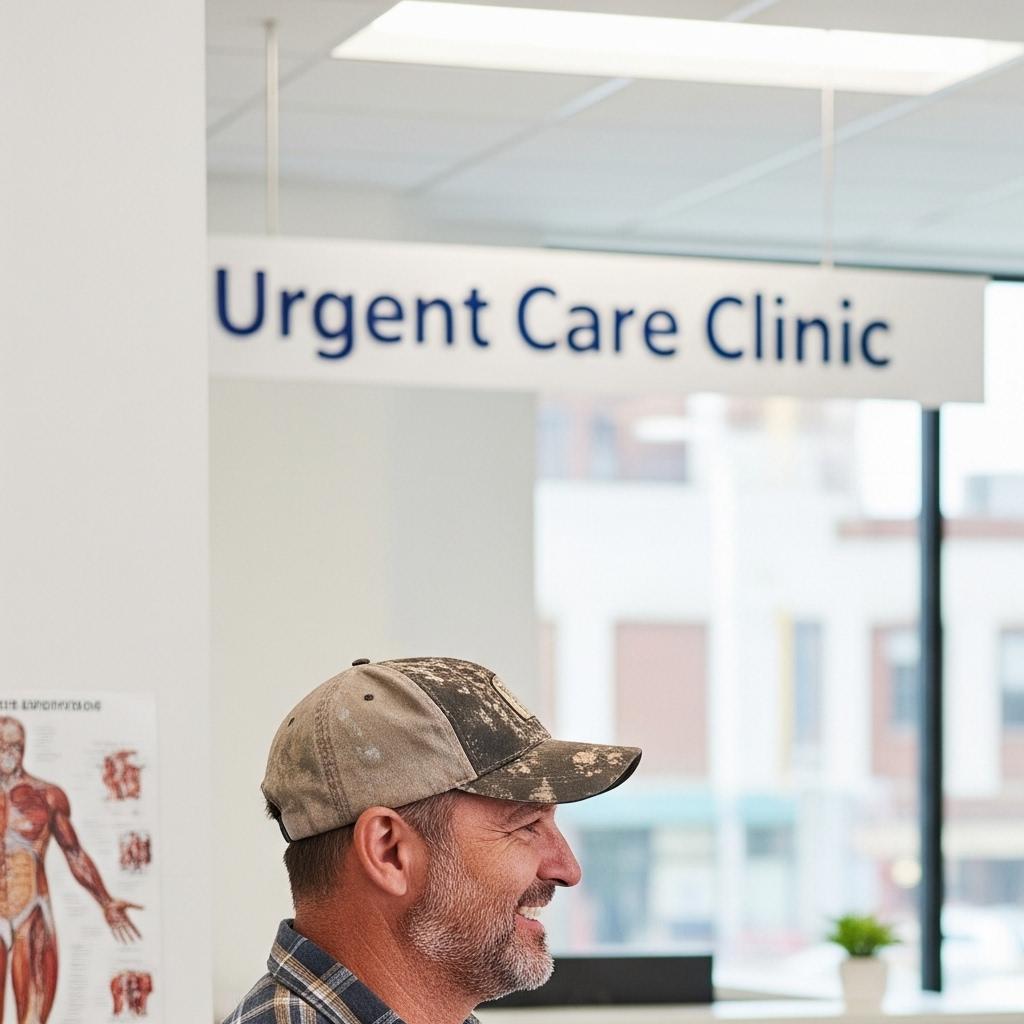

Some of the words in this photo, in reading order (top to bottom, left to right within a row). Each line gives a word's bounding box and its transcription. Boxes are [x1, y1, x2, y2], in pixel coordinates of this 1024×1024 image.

[214, 266, 491, 362] Urgent
[516, 285, 679, 358] Care
[704, 292, 892, 369] Clinic
